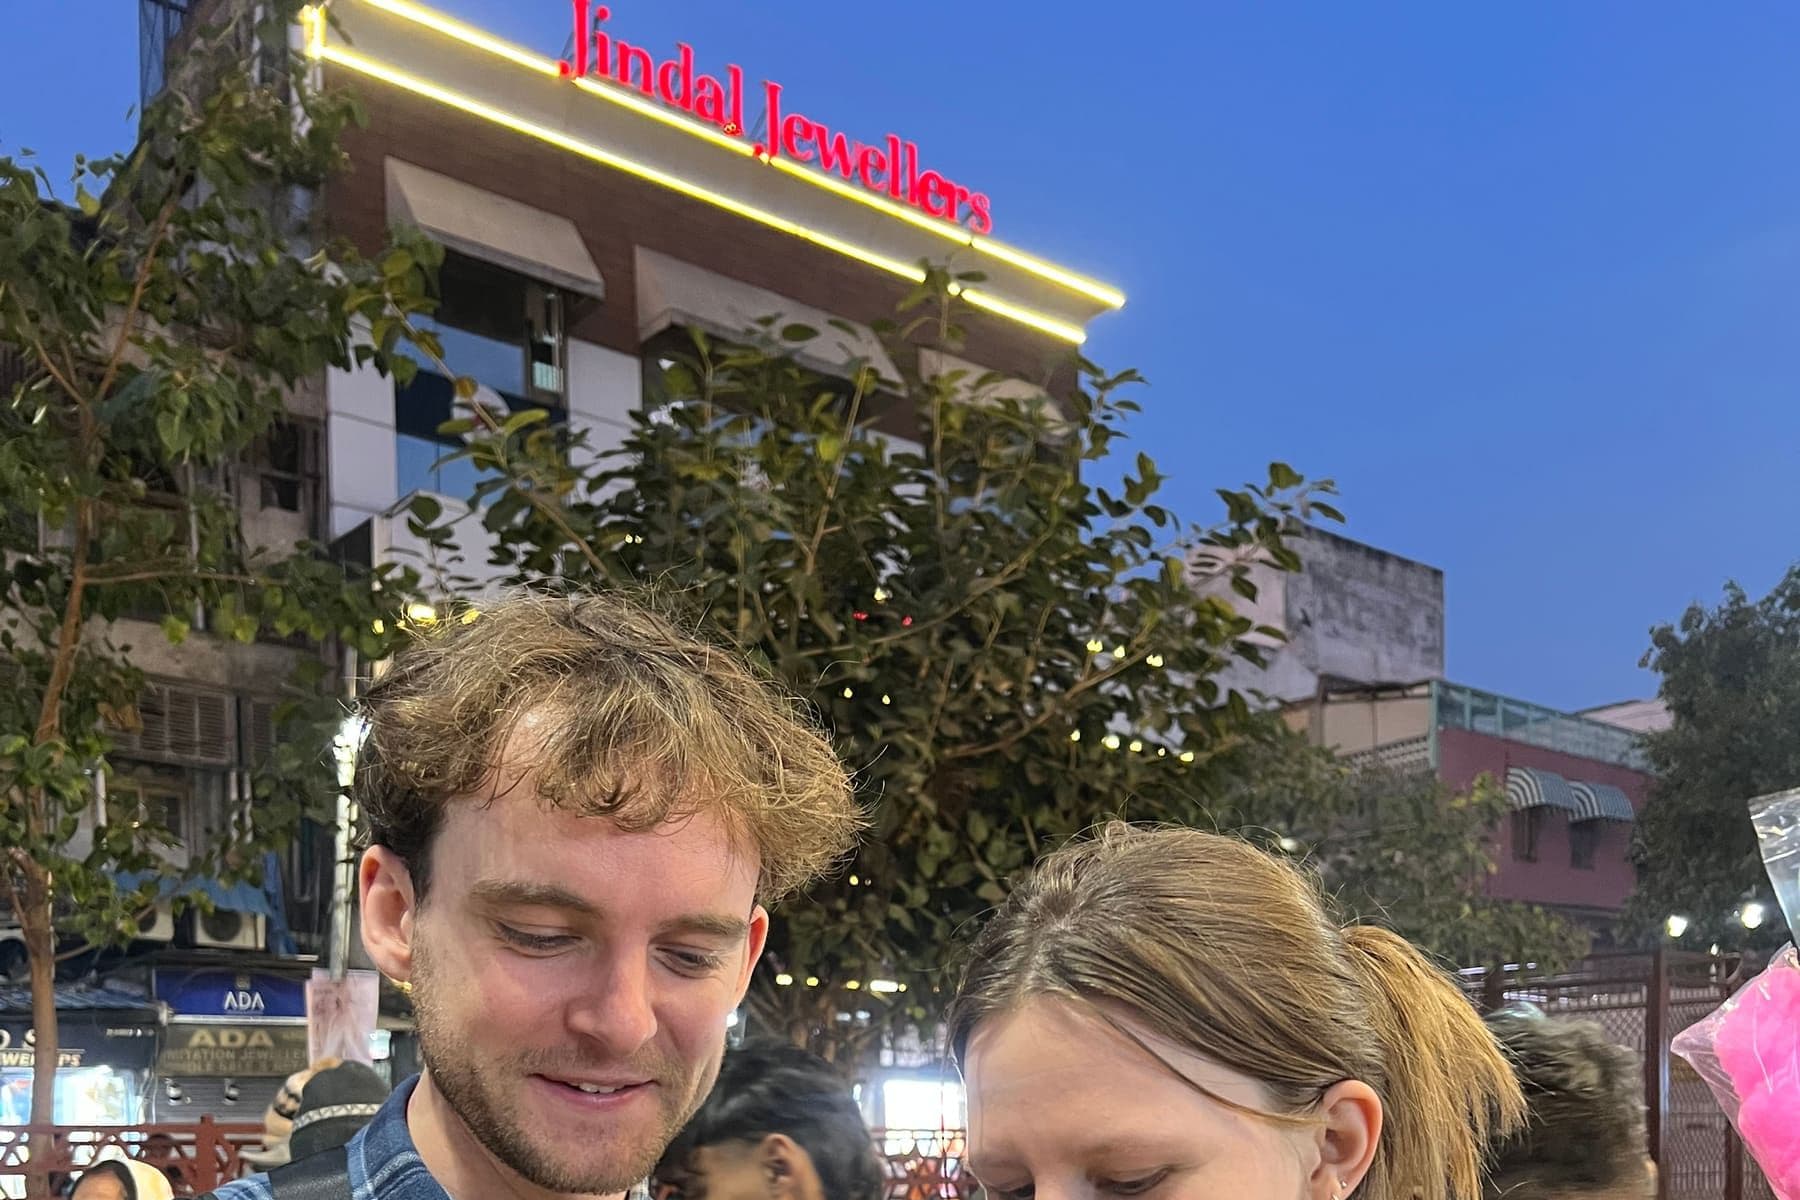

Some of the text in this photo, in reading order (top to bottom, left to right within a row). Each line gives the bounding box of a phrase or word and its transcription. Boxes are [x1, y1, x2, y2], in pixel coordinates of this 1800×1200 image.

[557, 0, 992, 235] Jindal Jewellers
[223, 991, 265, 1010] ADA
[188, 1028, 275, 1048] ADA
